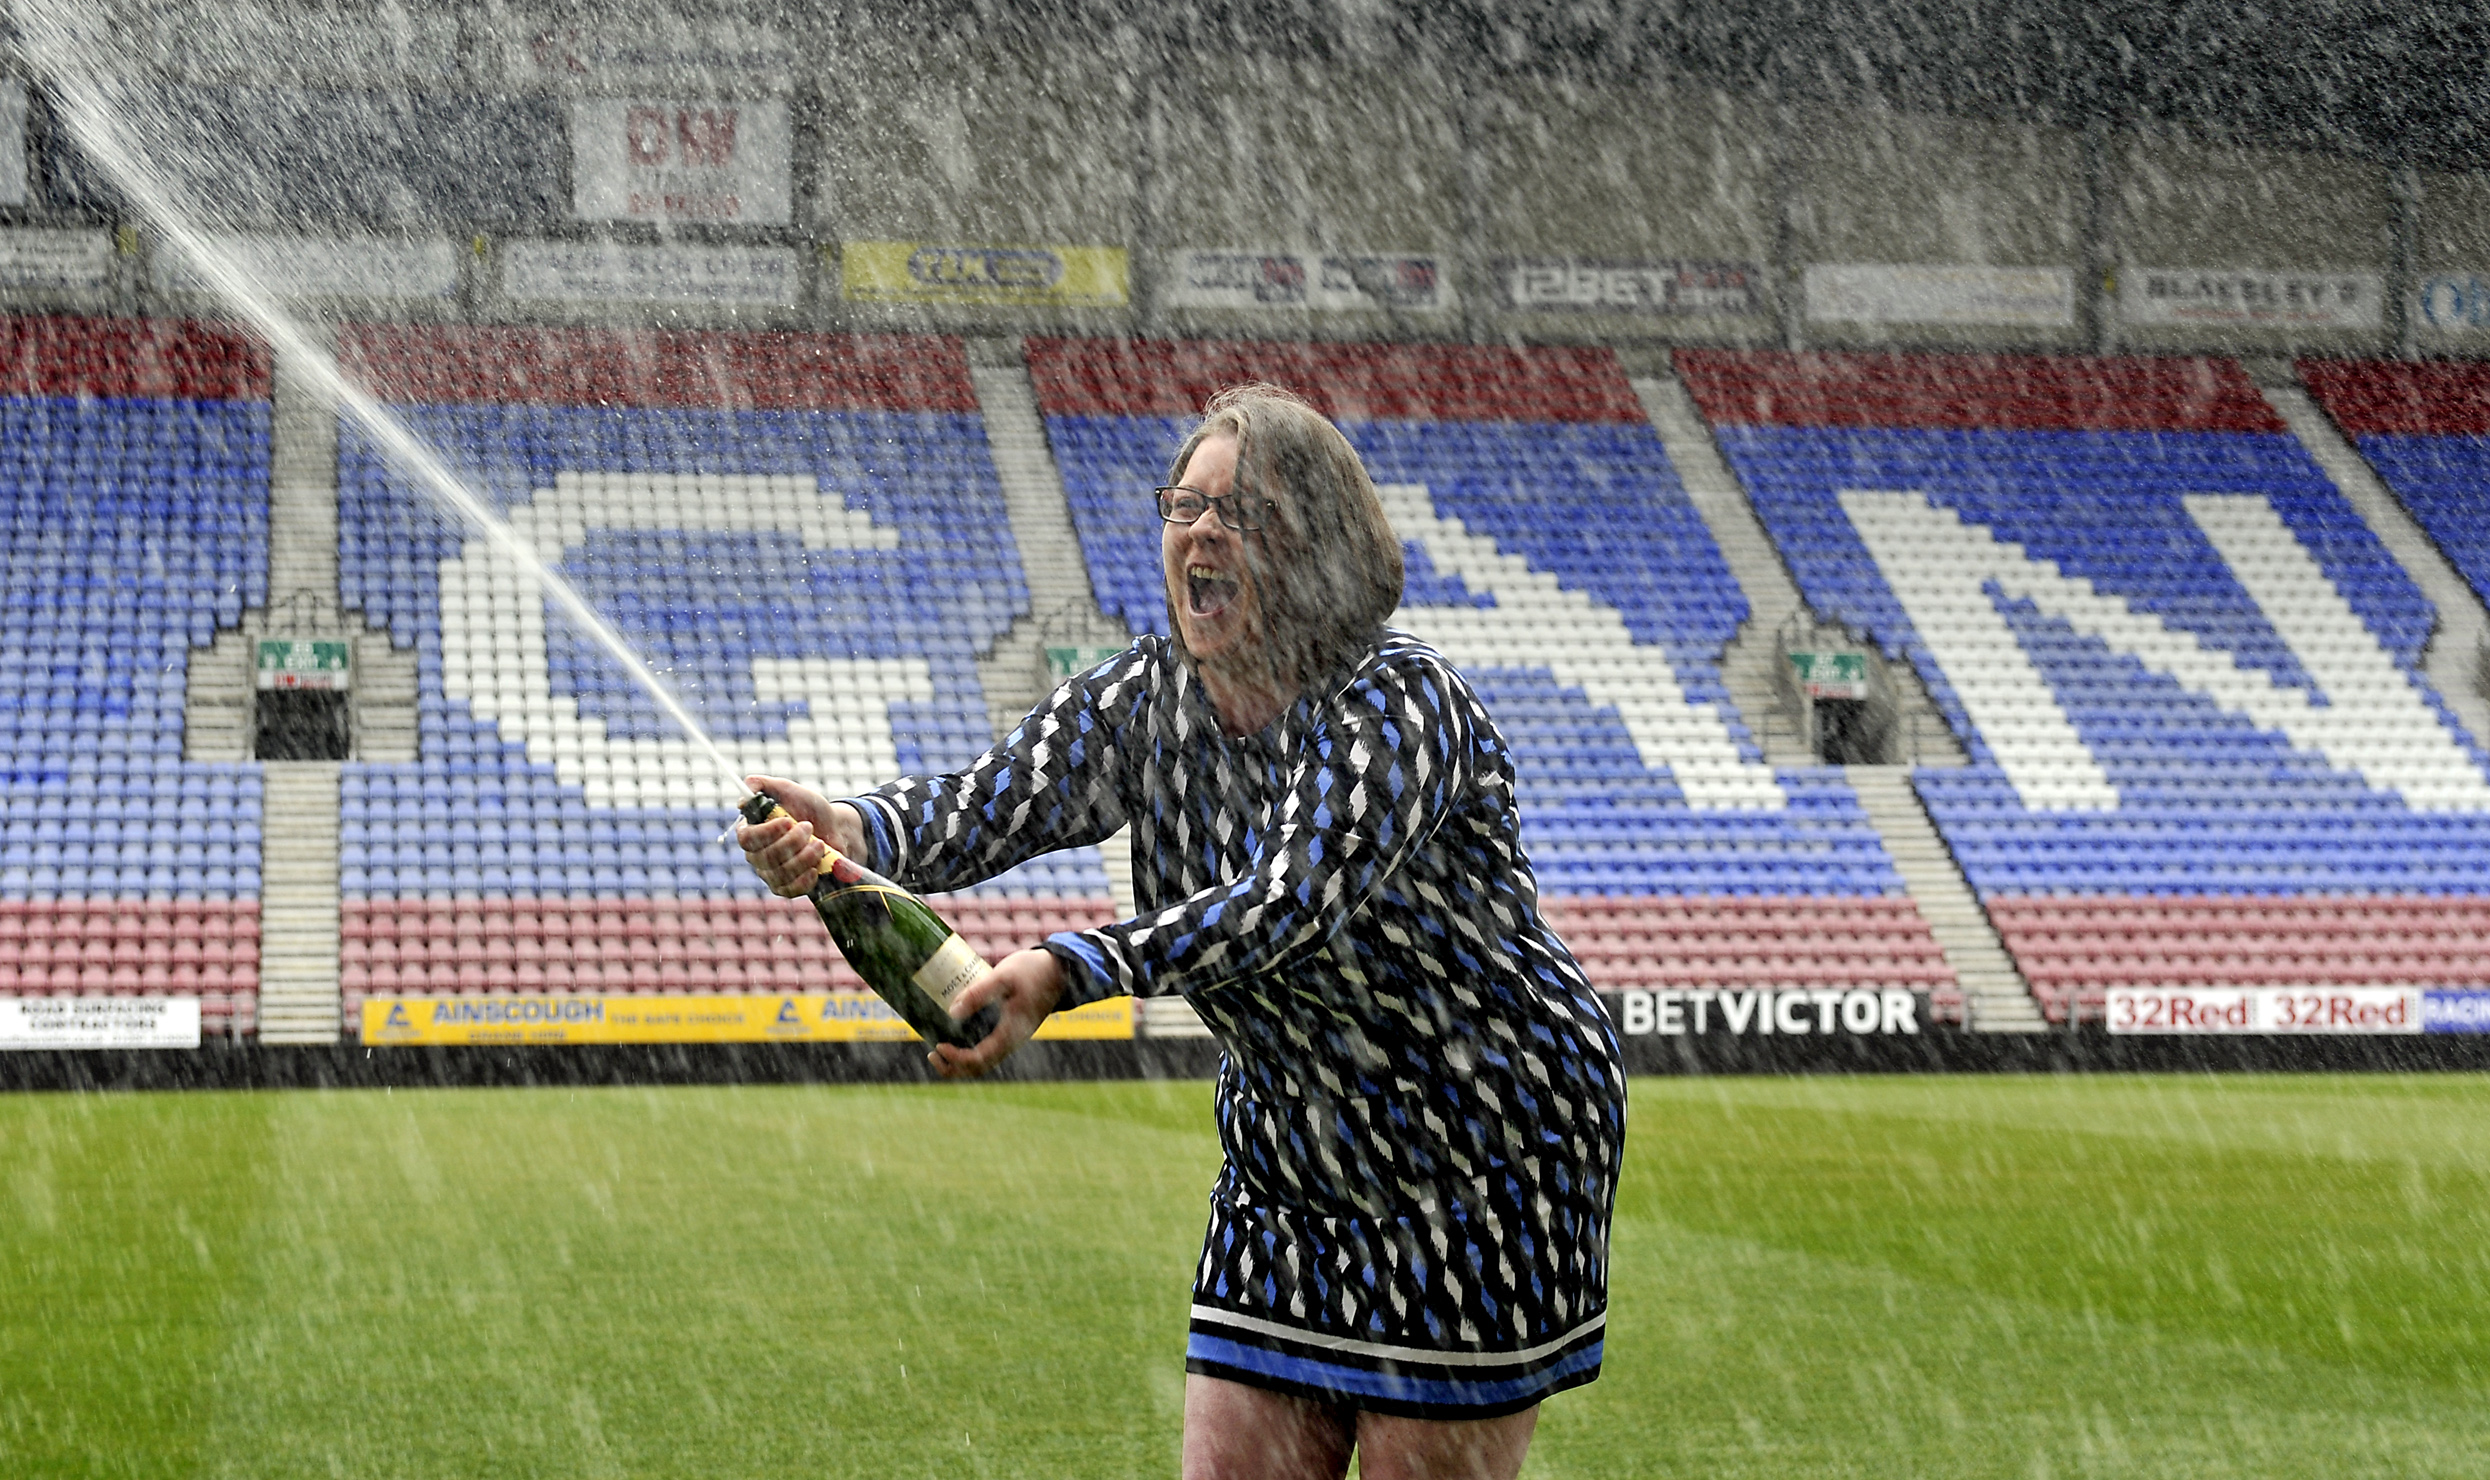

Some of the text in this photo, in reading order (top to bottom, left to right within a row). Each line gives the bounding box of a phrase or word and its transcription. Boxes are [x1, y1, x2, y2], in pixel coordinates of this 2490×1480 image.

[434, 1001, 605, 1024] AINSCOUGH
[2115, 997, 2246, 1025] 32Red
[2274, 997, 2405, 1025] 32Red
